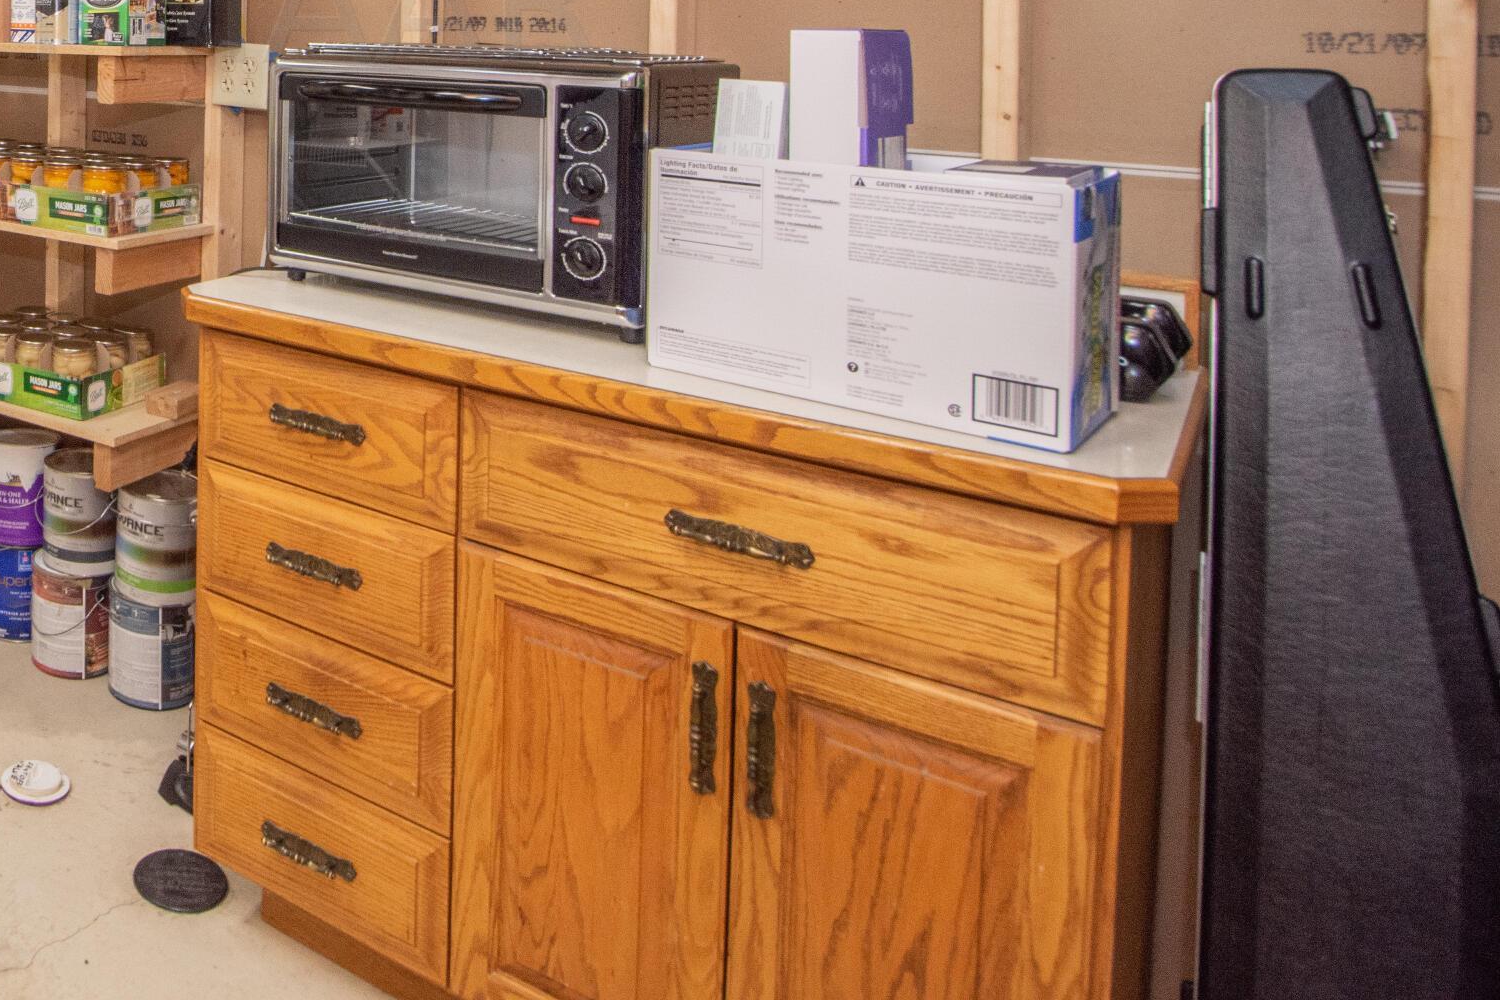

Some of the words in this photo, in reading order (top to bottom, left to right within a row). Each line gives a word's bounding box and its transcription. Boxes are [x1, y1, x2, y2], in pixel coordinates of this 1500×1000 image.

[660, 159, 687, 170] Lighting
[688, 161, 727, 172] Facts/Datos
[876, 180, 906, 189] CAUTION
[915, 184, 975, 196] AVERTISSEMENT
[984, 190, 1033, 201] PRECAUCIÓN
[55, 200, 73, 212] MASON
[74, 202, 88, 214] JARS
[29, 375, 47, 388] MASON
[48, 378, 62, 391] JARS
